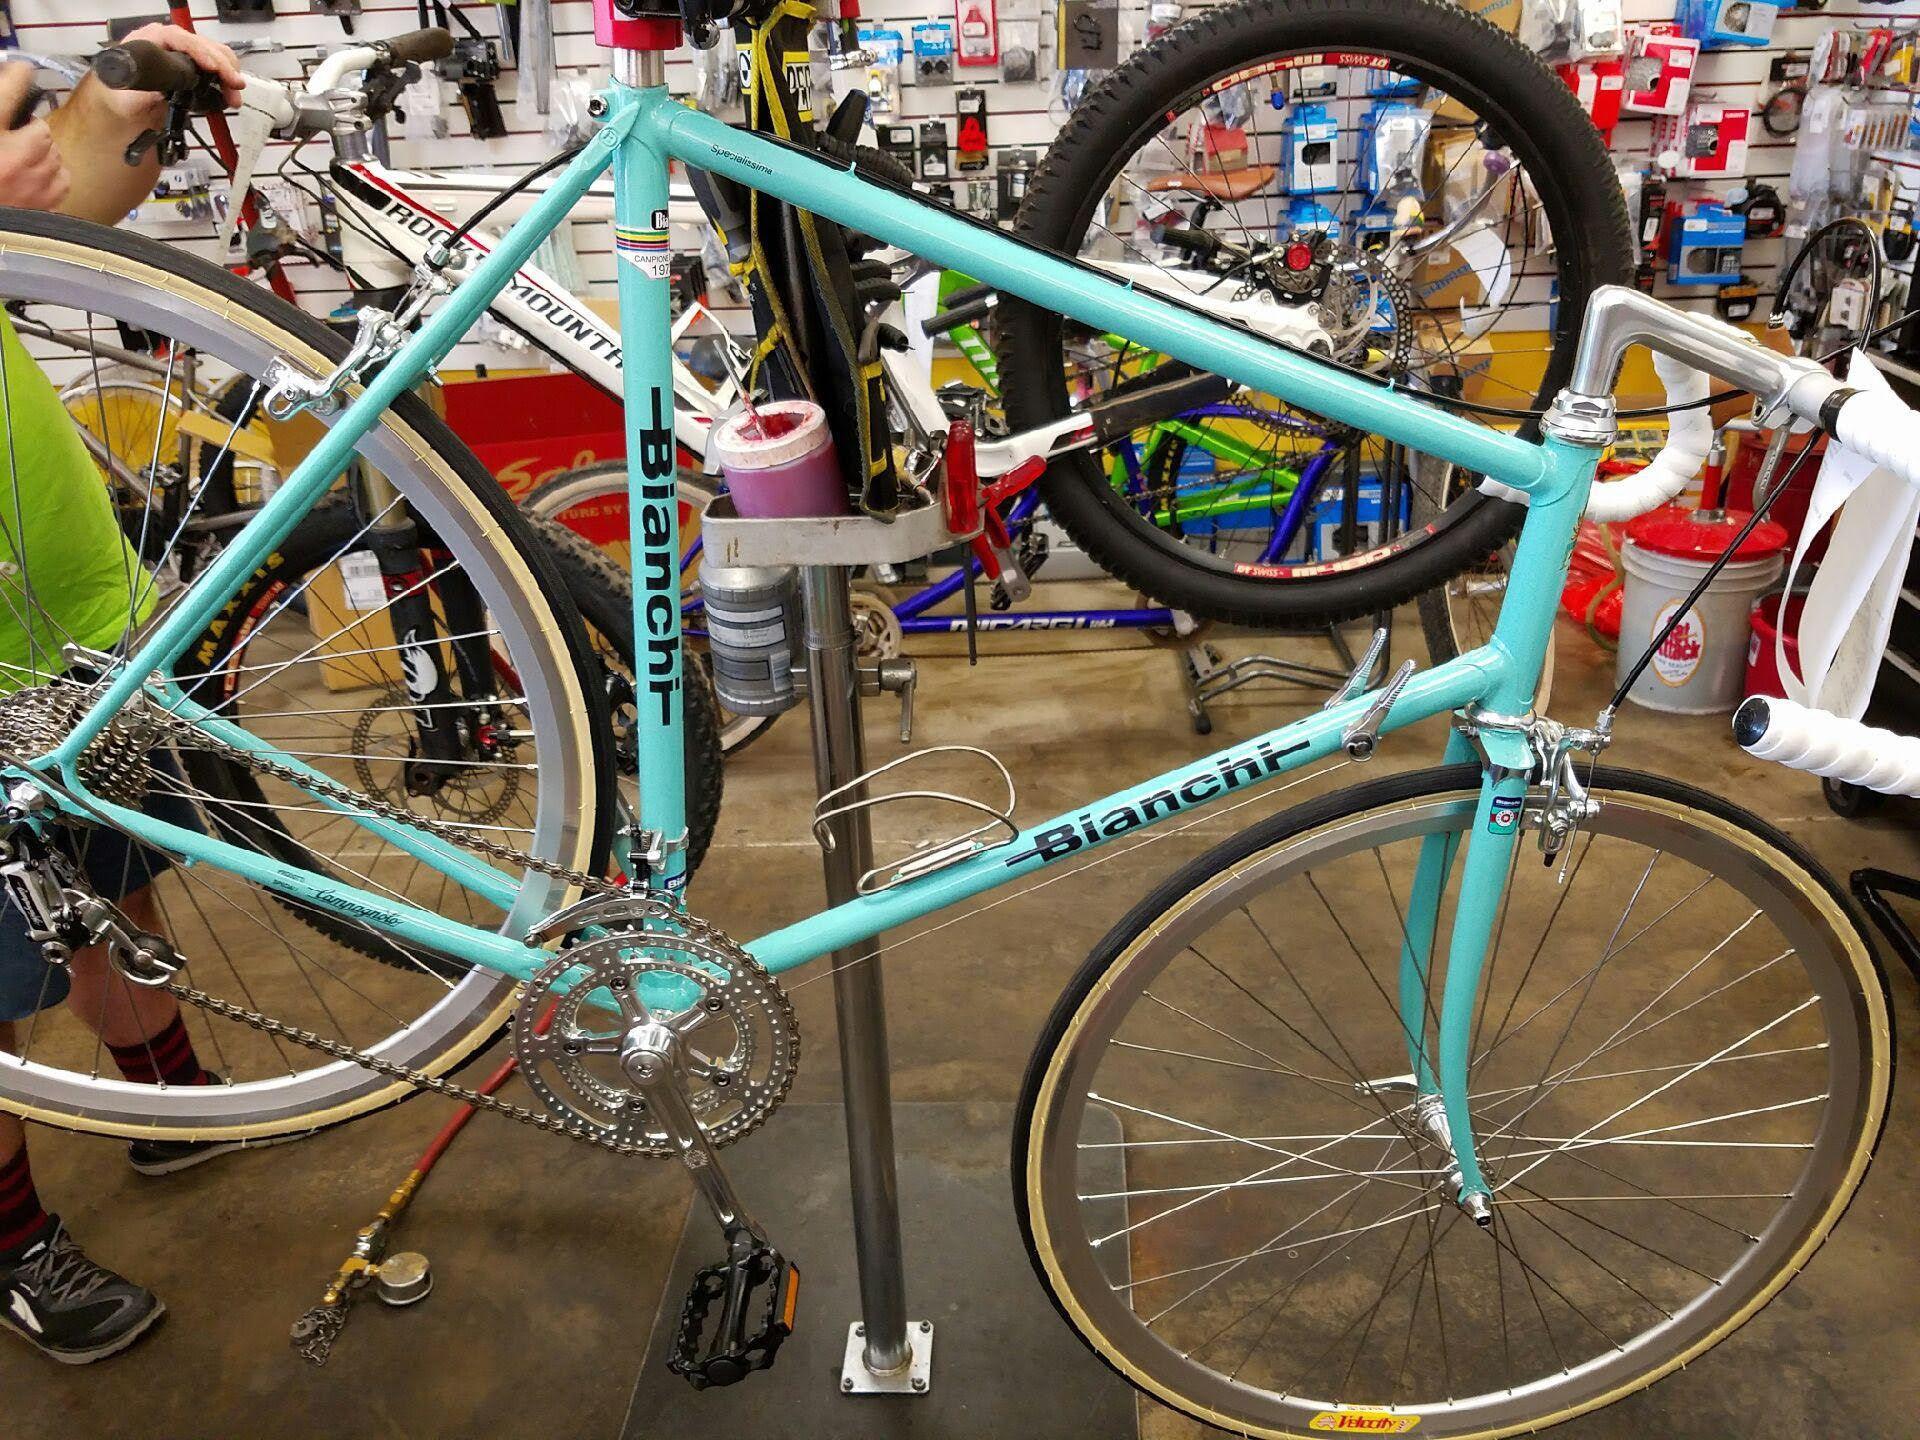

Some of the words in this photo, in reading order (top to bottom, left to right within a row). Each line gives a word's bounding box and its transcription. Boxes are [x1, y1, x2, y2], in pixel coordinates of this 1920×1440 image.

[1338, 54, 1370, 65] SWISS
[1370, 57, 1391, 68] DT
[710, 143, 774, 176] Specialissima
[639, 386, 684, 726] Bianchi
[1253, 568, 1277, 577] SWISS
[1005, 741, 1311, 868] Bianchi
[308, 887, 405, 927] Campagnolo
[1339, 1415, 1396, 1431] Velocity
